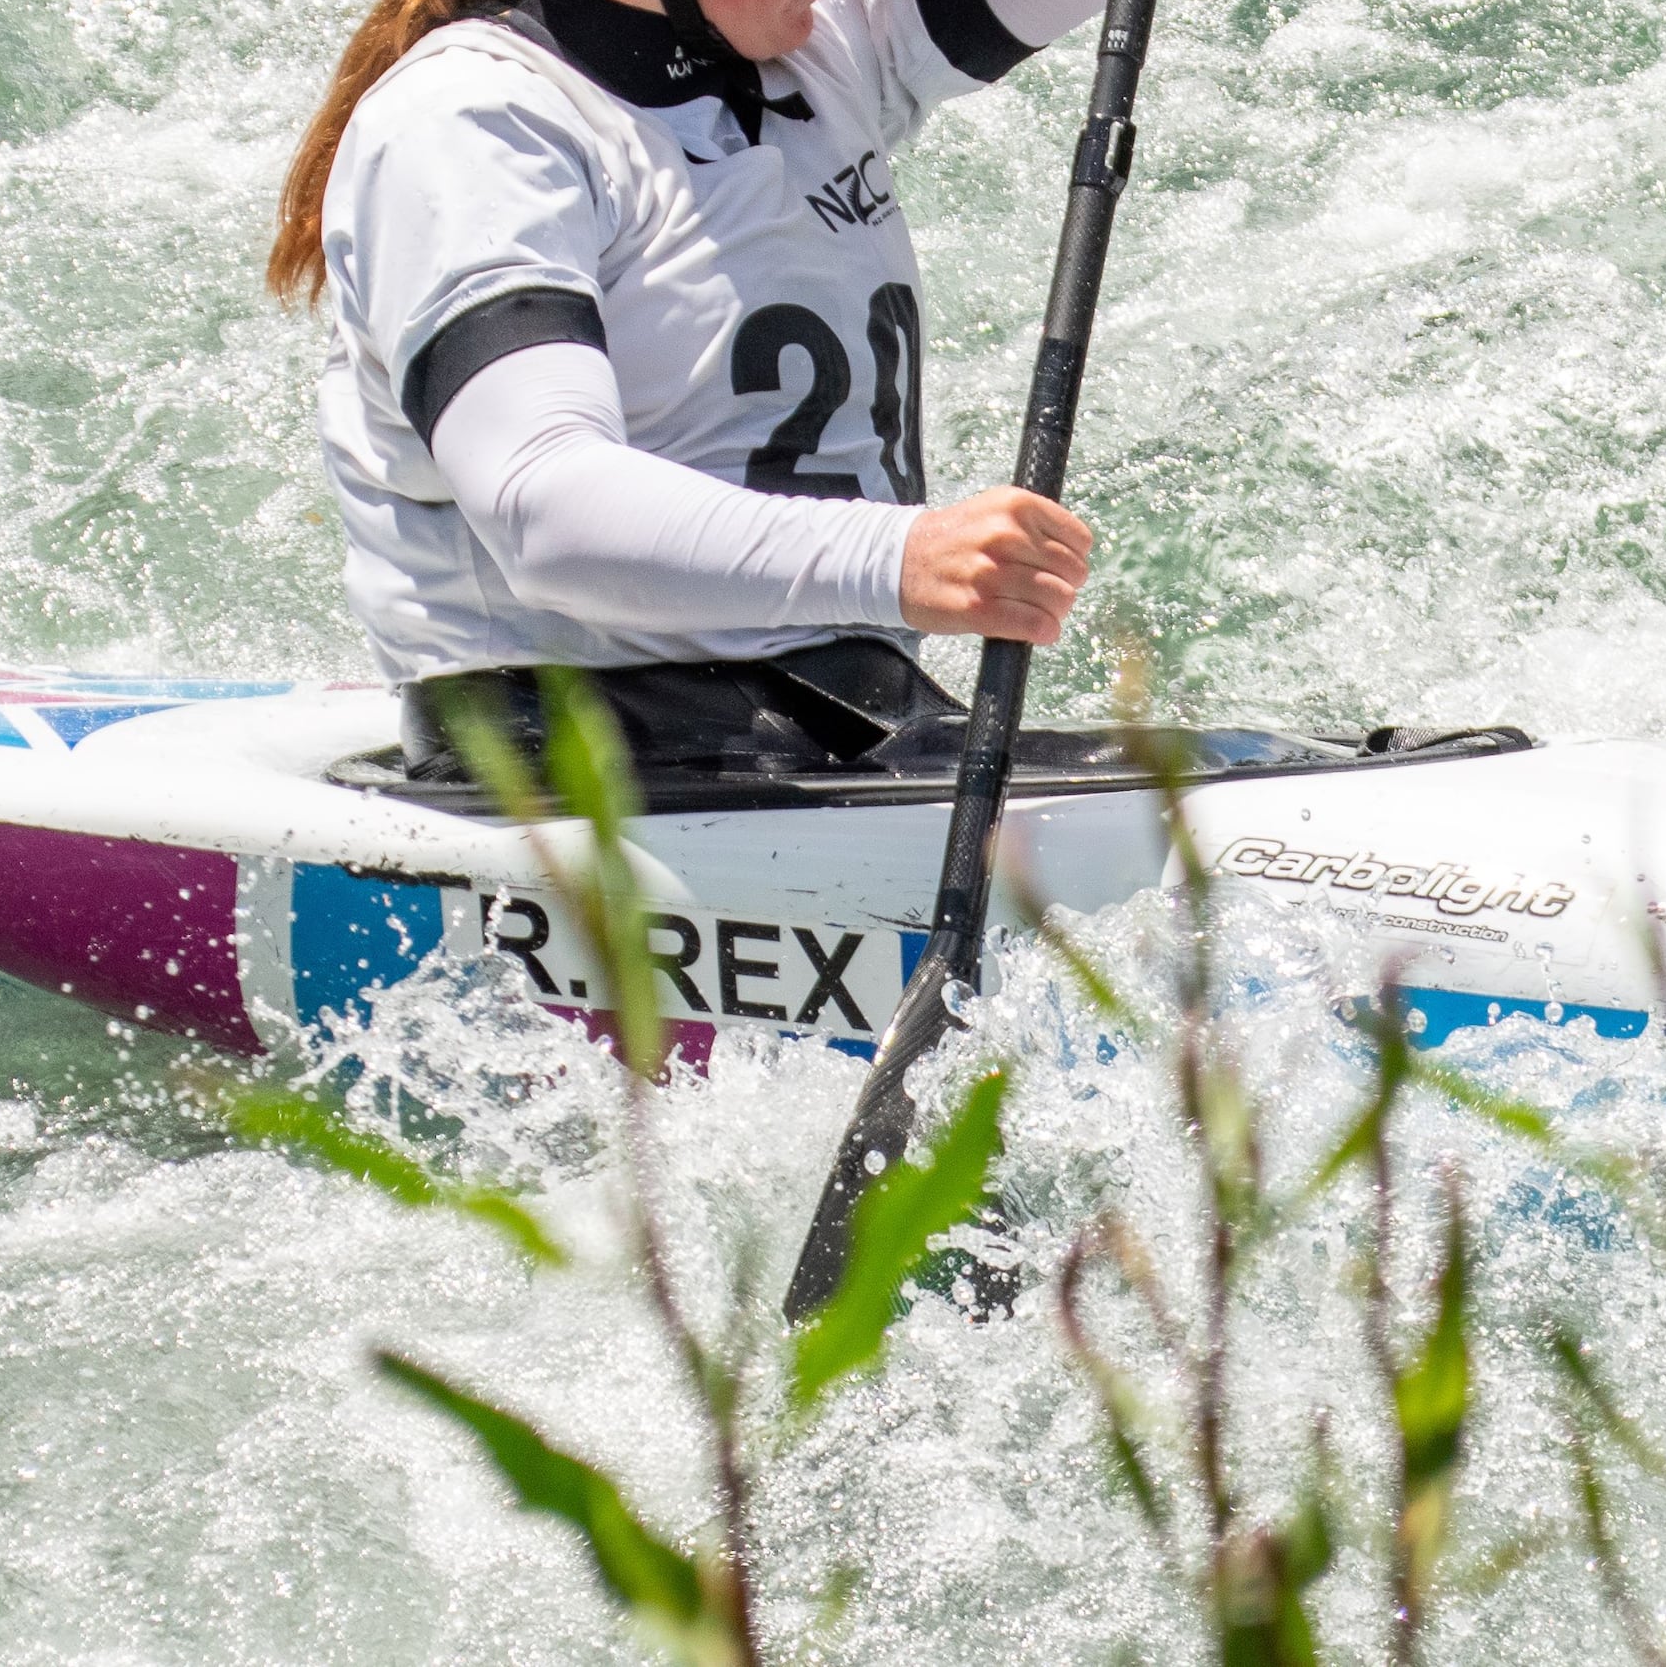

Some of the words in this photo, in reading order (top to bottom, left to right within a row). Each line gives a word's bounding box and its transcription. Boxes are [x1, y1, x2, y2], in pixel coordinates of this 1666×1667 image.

[804, 147, 890, 234] NZC
[731, 282, 927, 506] 20
[1217, 837, 1575, 917] Carbolight
[1381, 913, 1509, 943] construction
[638, 911, 874, 1033] REX
